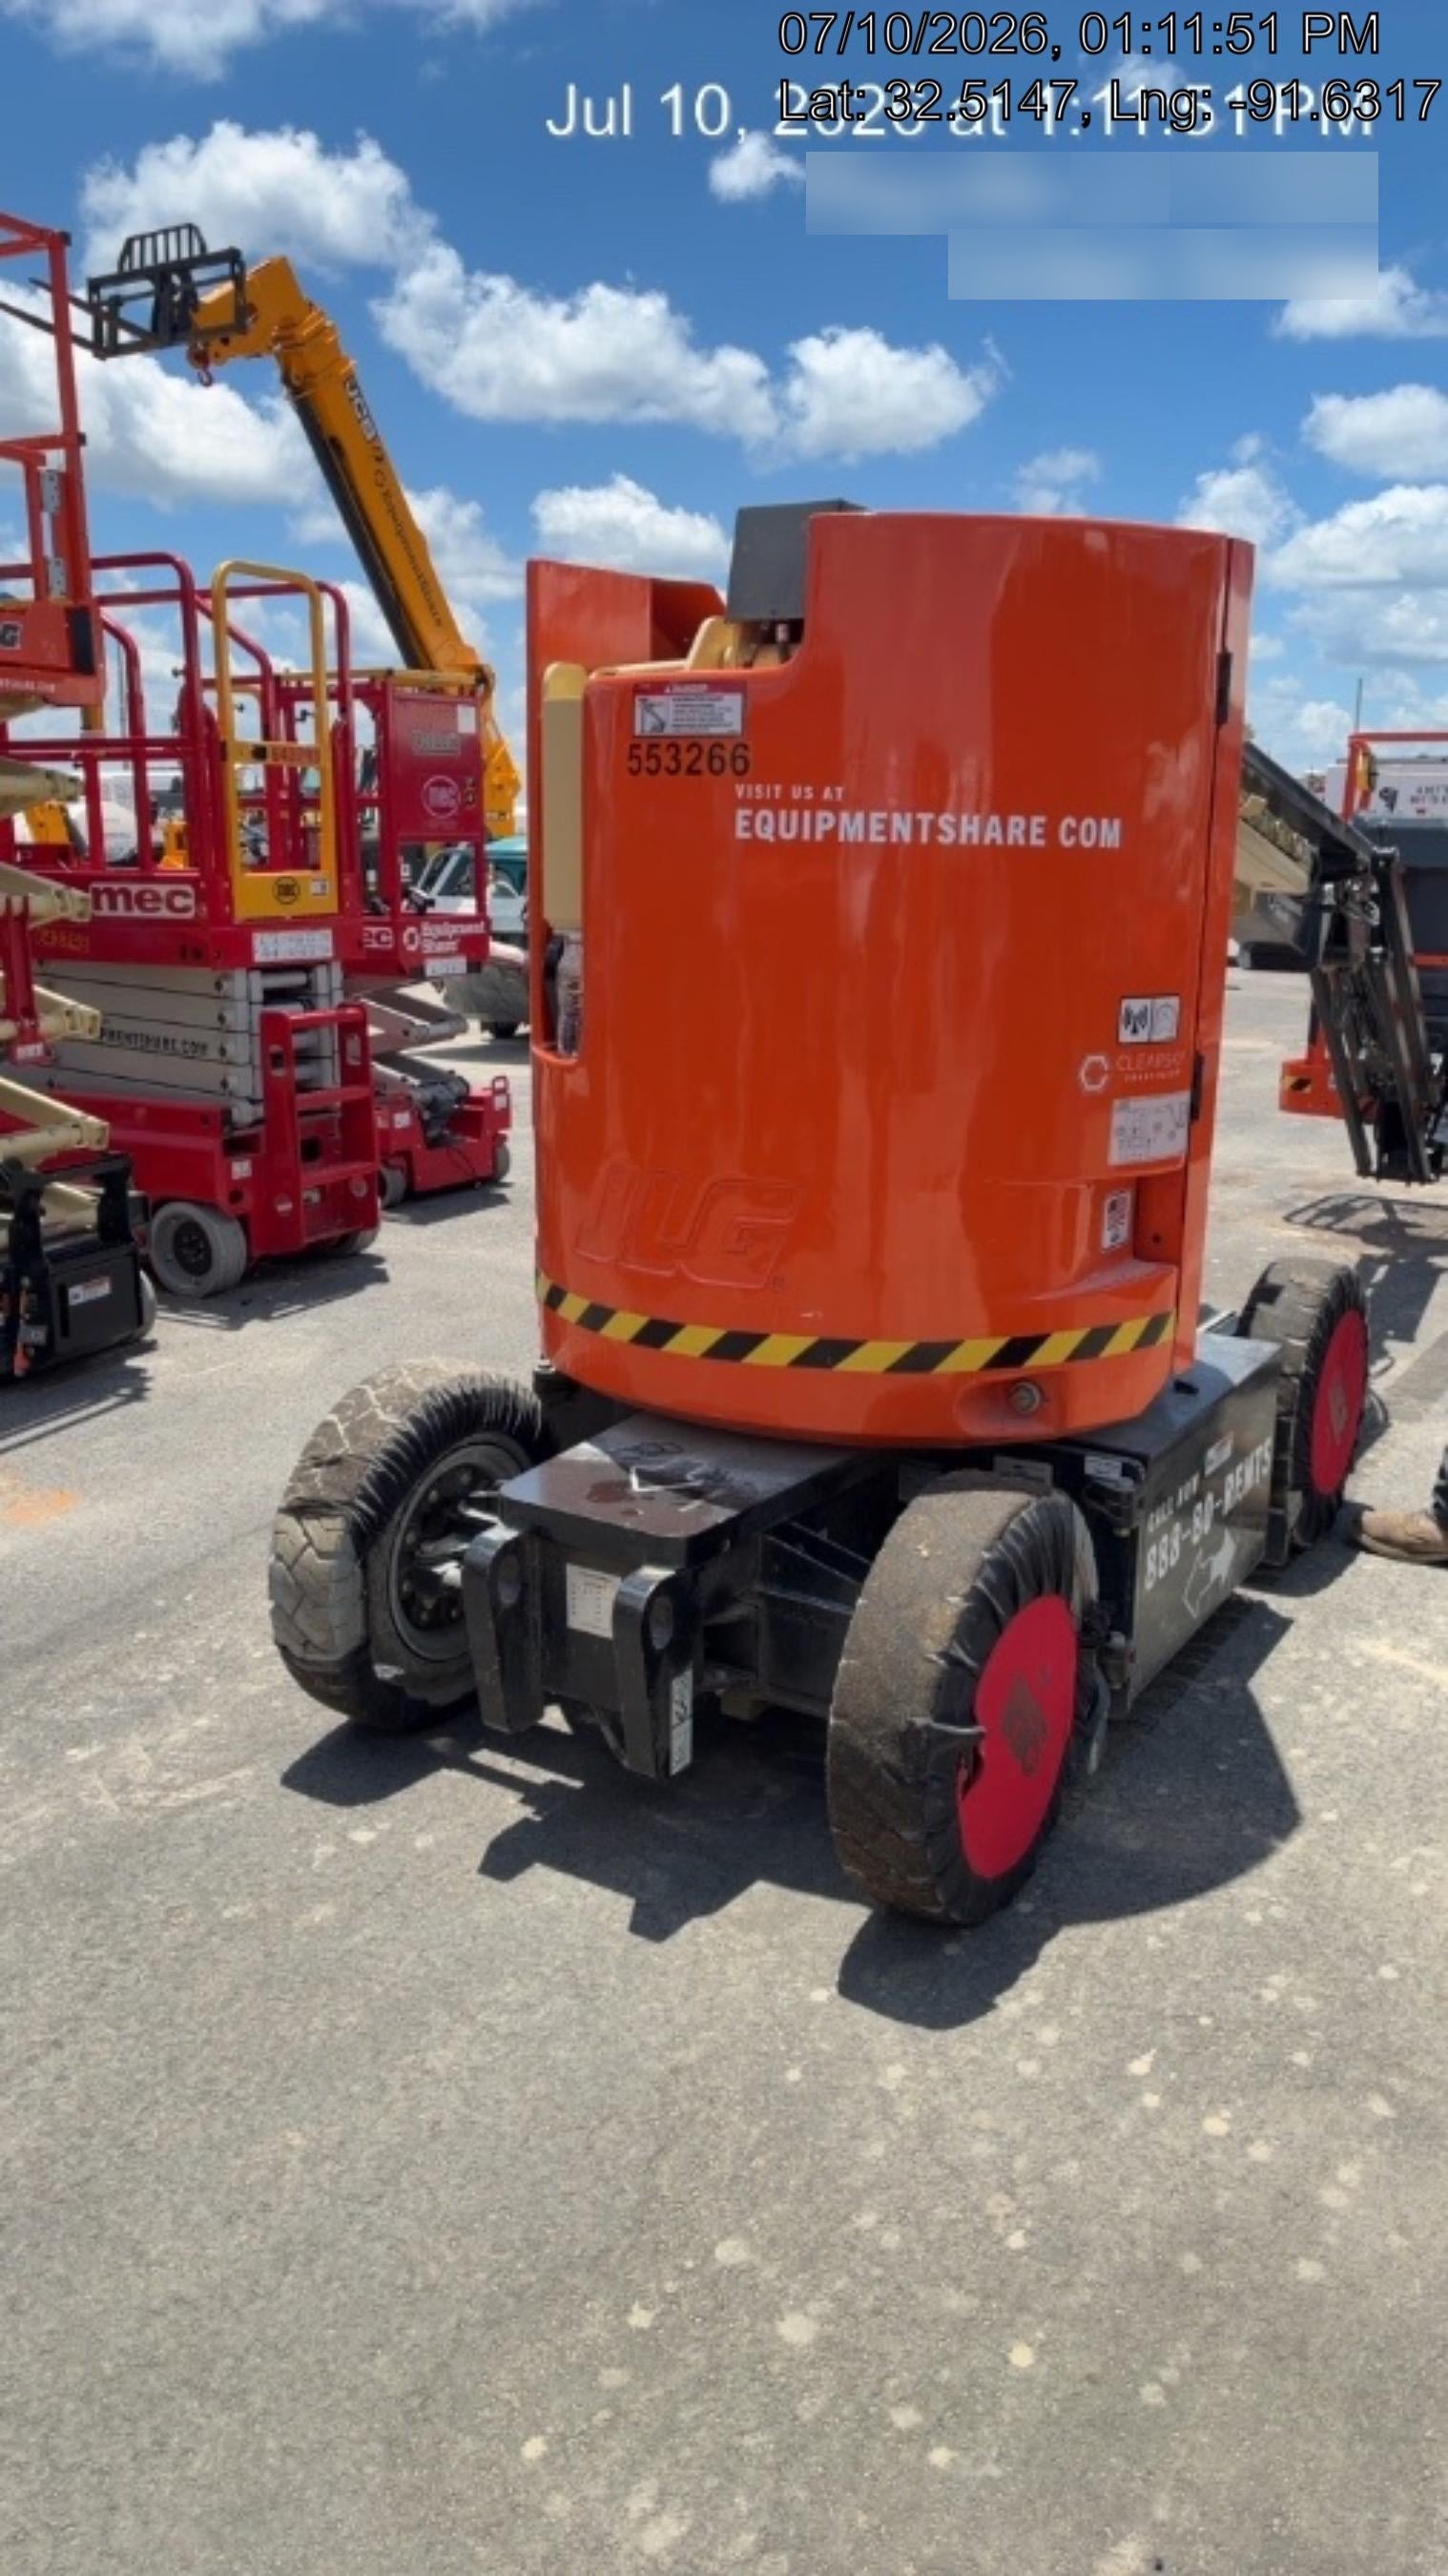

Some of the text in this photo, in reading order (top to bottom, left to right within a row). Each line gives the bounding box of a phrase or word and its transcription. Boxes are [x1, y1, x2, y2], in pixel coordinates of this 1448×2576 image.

[628, 741, 750, 776] 553266
[735, 783, 844, 800] VISIT US AT
[92, 886, 192, 913] mec
